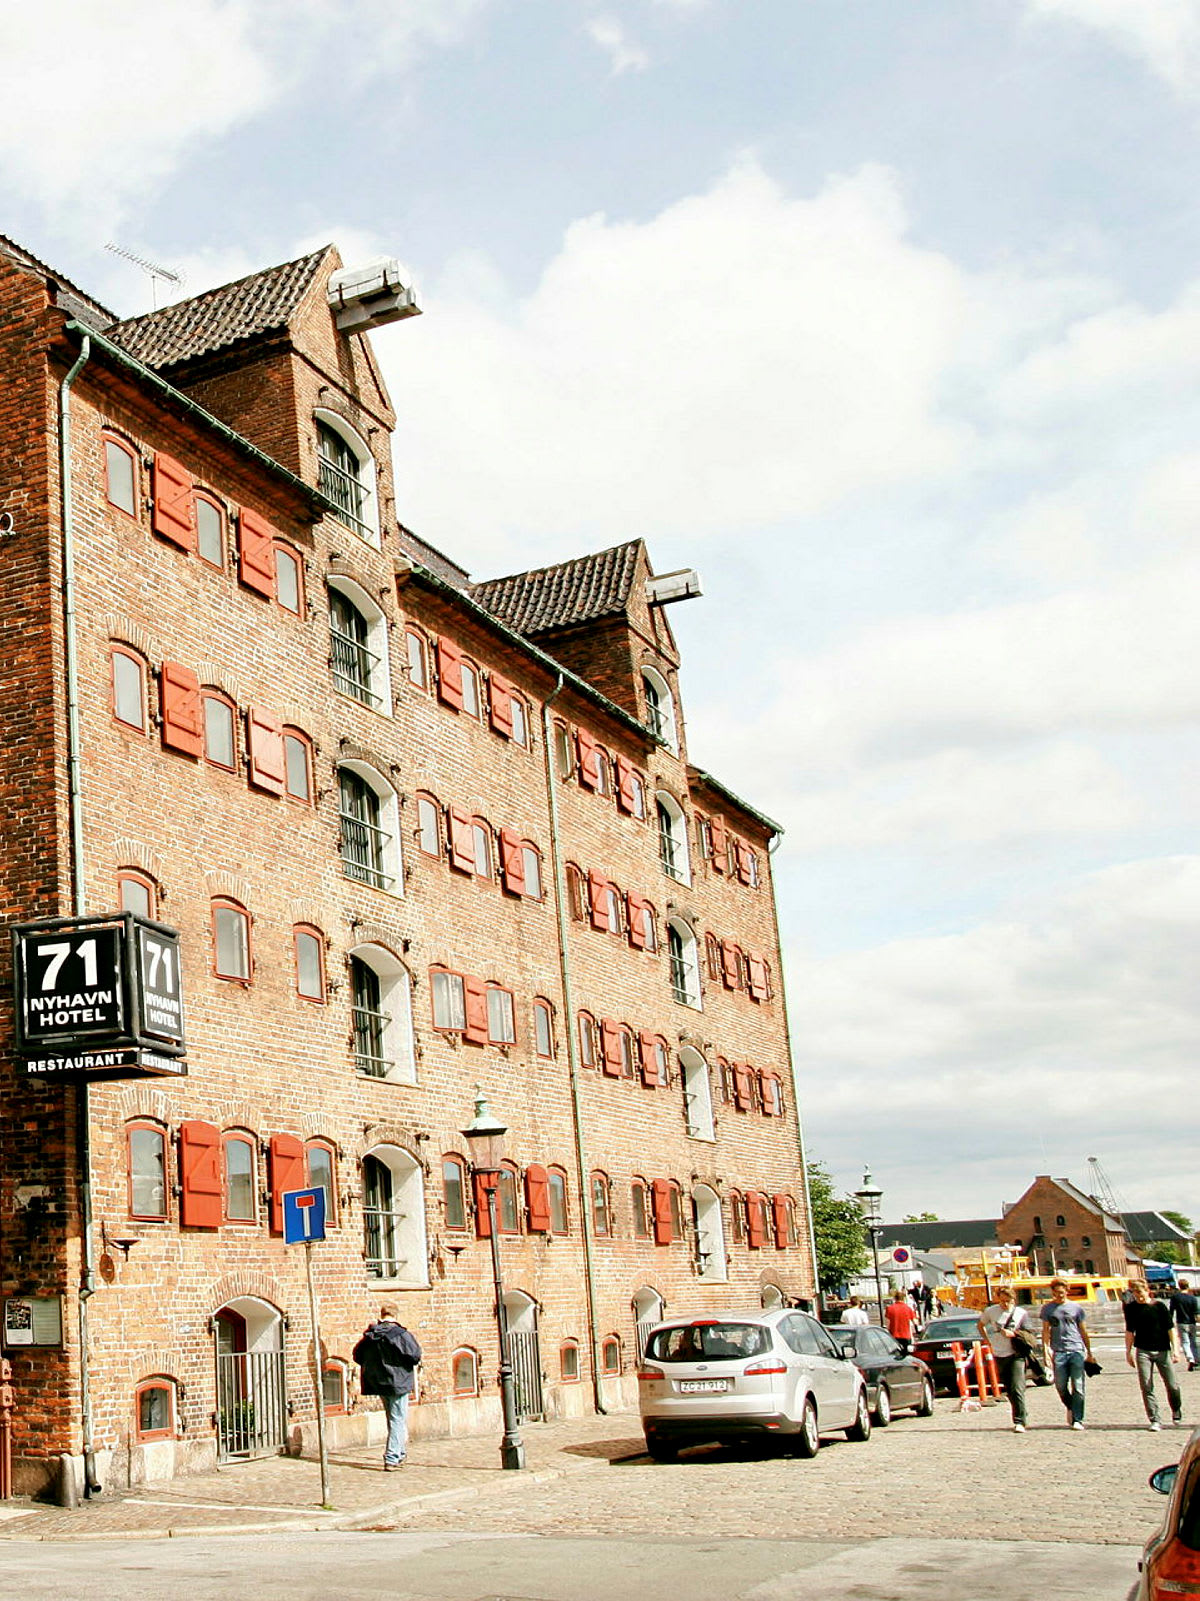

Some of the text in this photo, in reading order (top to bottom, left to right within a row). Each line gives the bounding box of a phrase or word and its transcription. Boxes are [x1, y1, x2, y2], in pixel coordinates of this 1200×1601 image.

[37, 939, 98, 991] 71
[146, 940, 173, 993] 71
[30, 990, 112, 1012] NYHAVN
[40, 1008, 106, 1027] HOTEL
[150, 1009, 178, 1028] HOTEL
[27, 1053, 124, 1073] RESTAURANT
